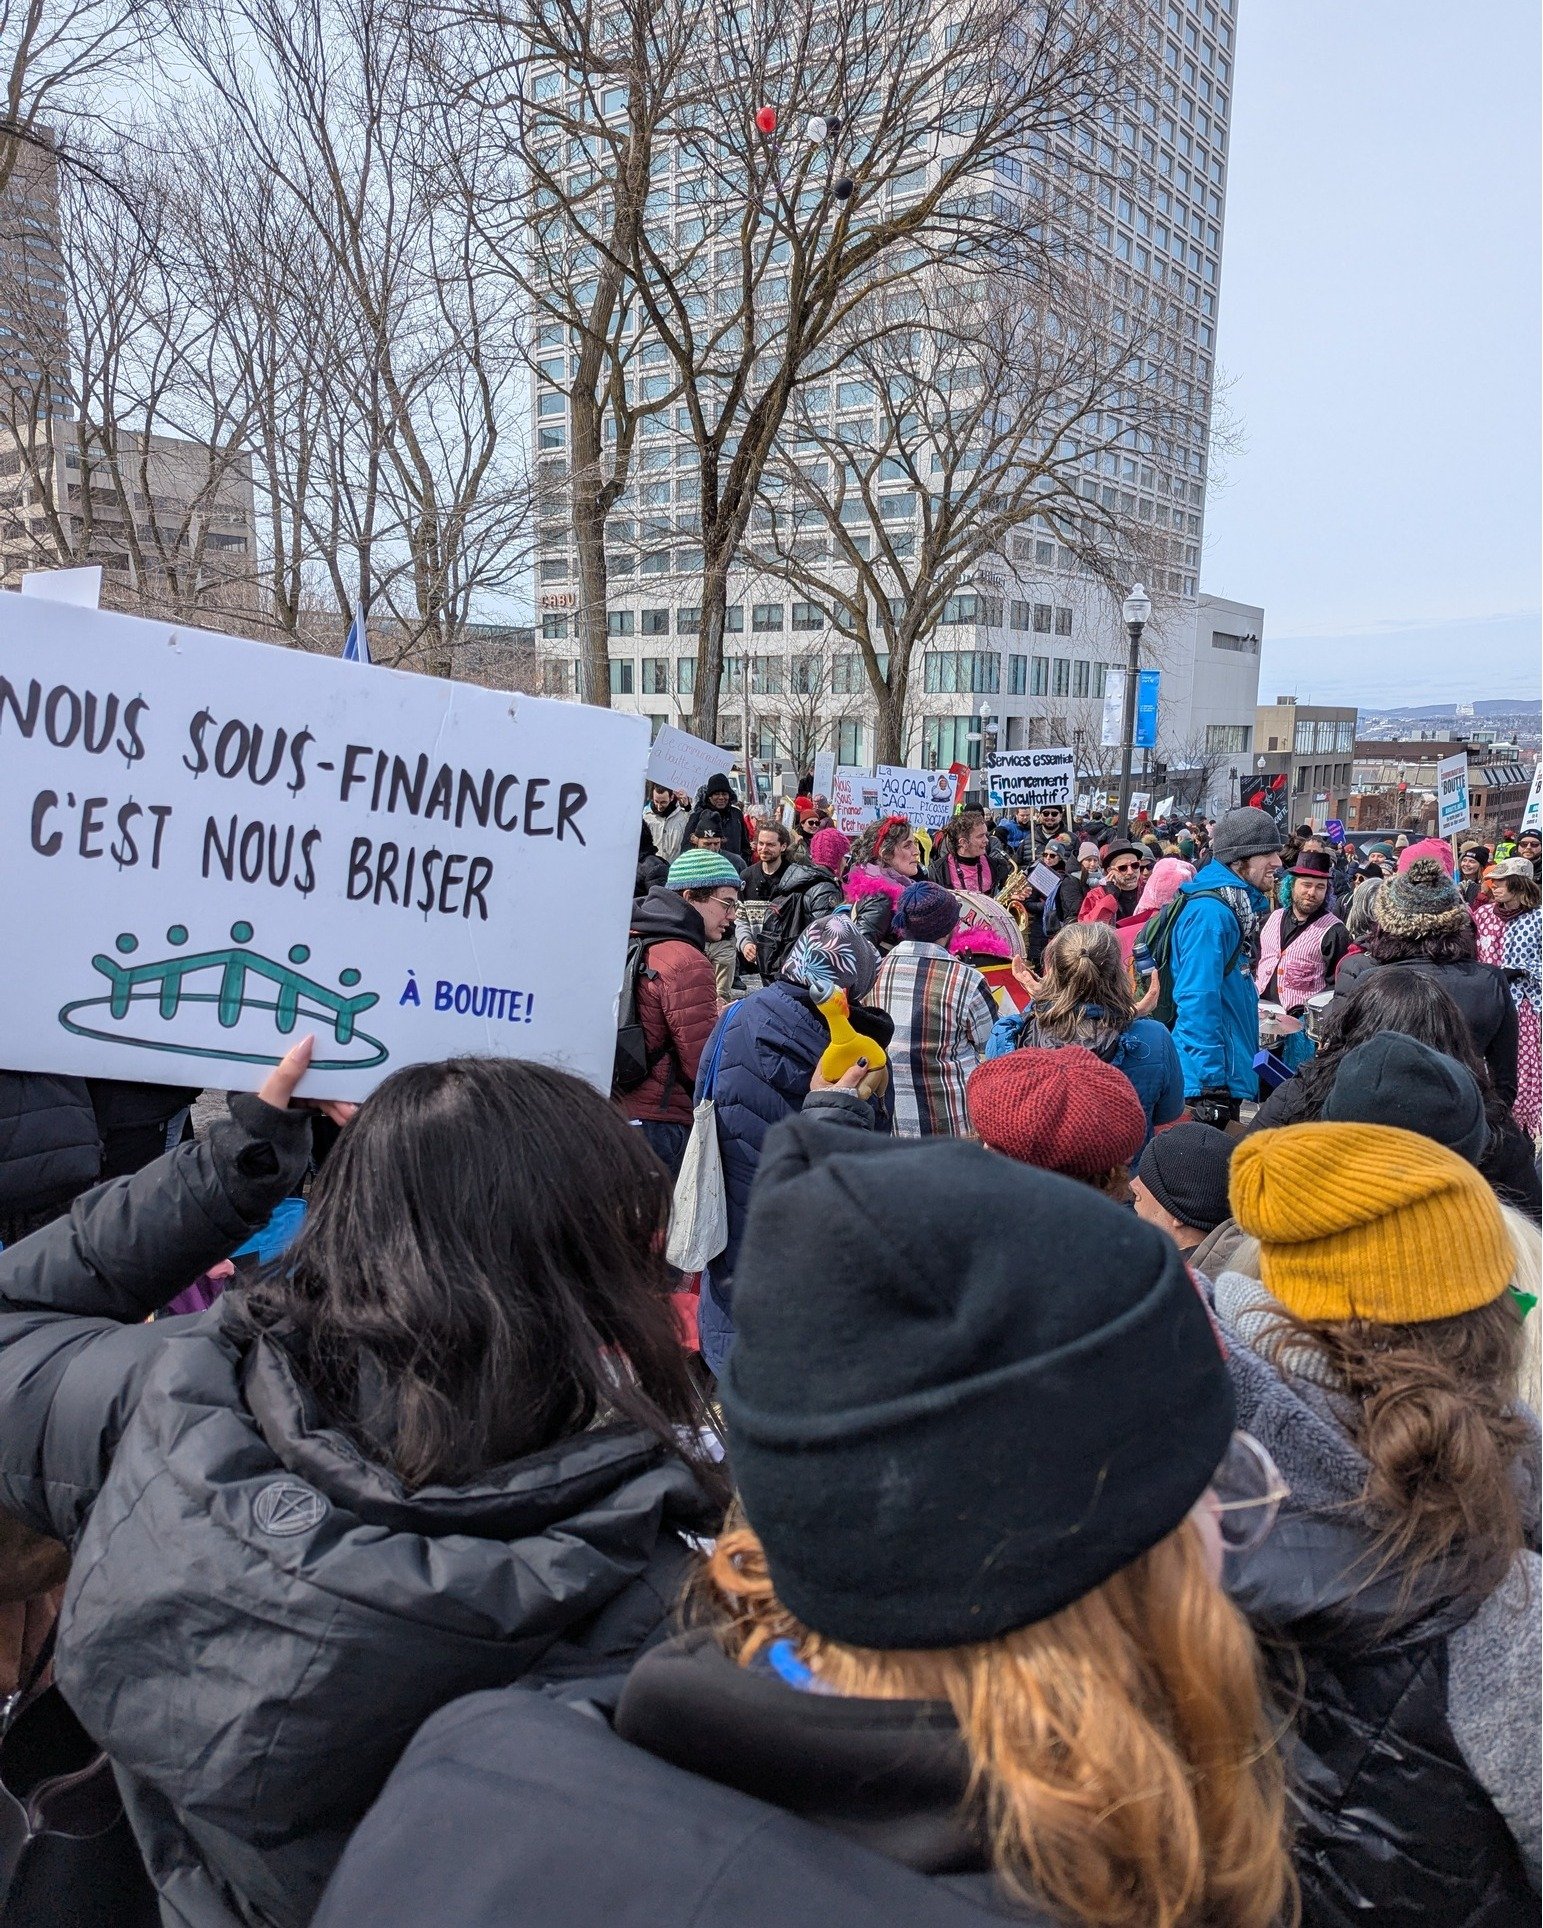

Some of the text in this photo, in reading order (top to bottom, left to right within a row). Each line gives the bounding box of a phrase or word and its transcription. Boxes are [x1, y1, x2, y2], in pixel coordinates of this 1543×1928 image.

[987, 752, 1032, 769] Services
[878, 767, 892, 776] La
[834, 776, 851, 793] Nous
[990, 772, 1069, 790] Financement
[1443, 774, 1465, 796] BOUTTE
[399, 969, 534, 1023] À BOUTTE!
